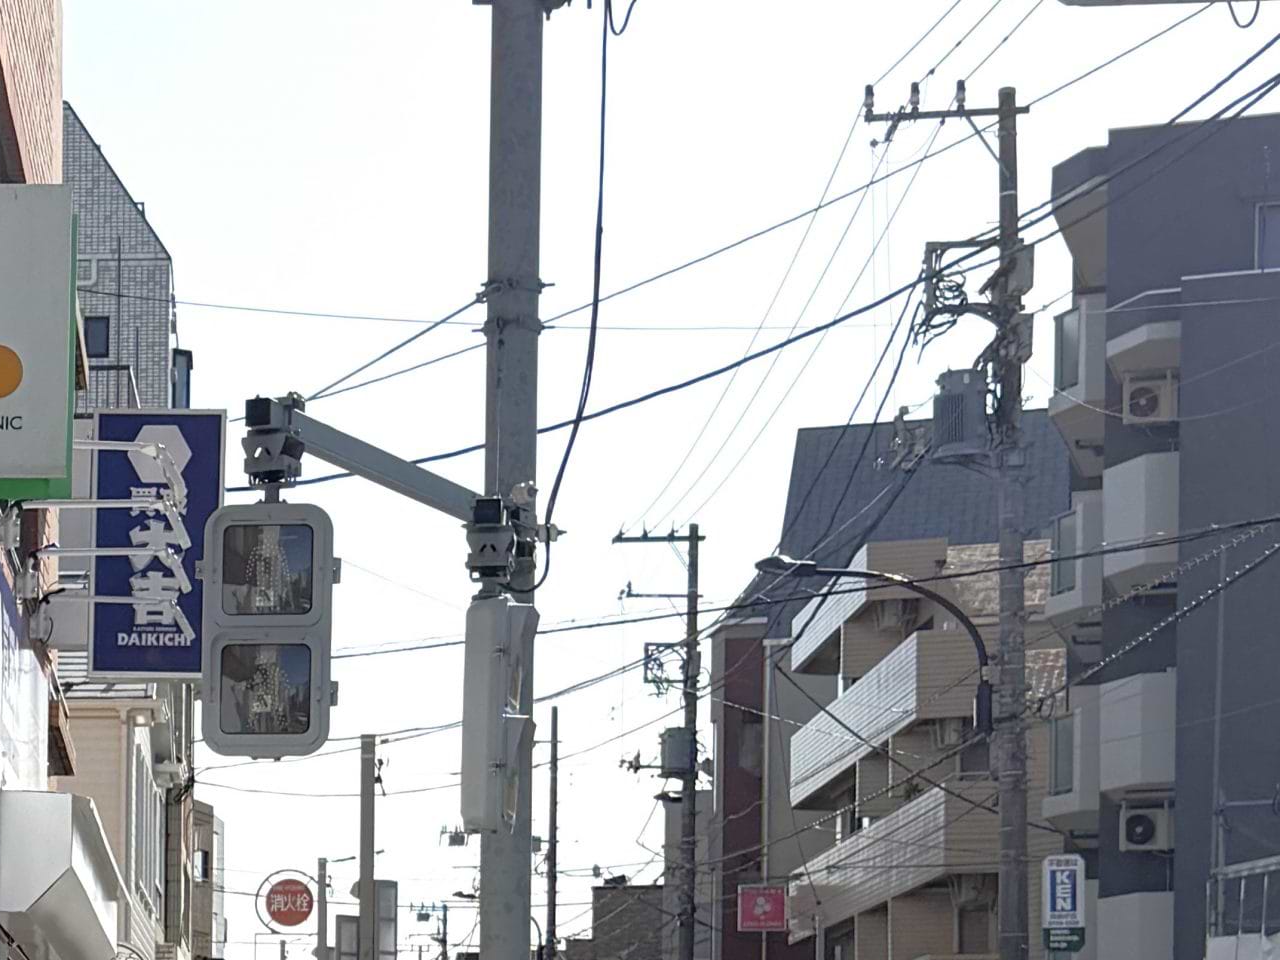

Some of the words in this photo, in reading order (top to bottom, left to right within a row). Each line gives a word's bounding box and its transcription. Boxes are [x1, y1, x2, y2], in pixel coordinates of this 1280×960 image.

[271, 893, 310, 912] 消火栓
[1055, 870, 1072, 911] KEN
